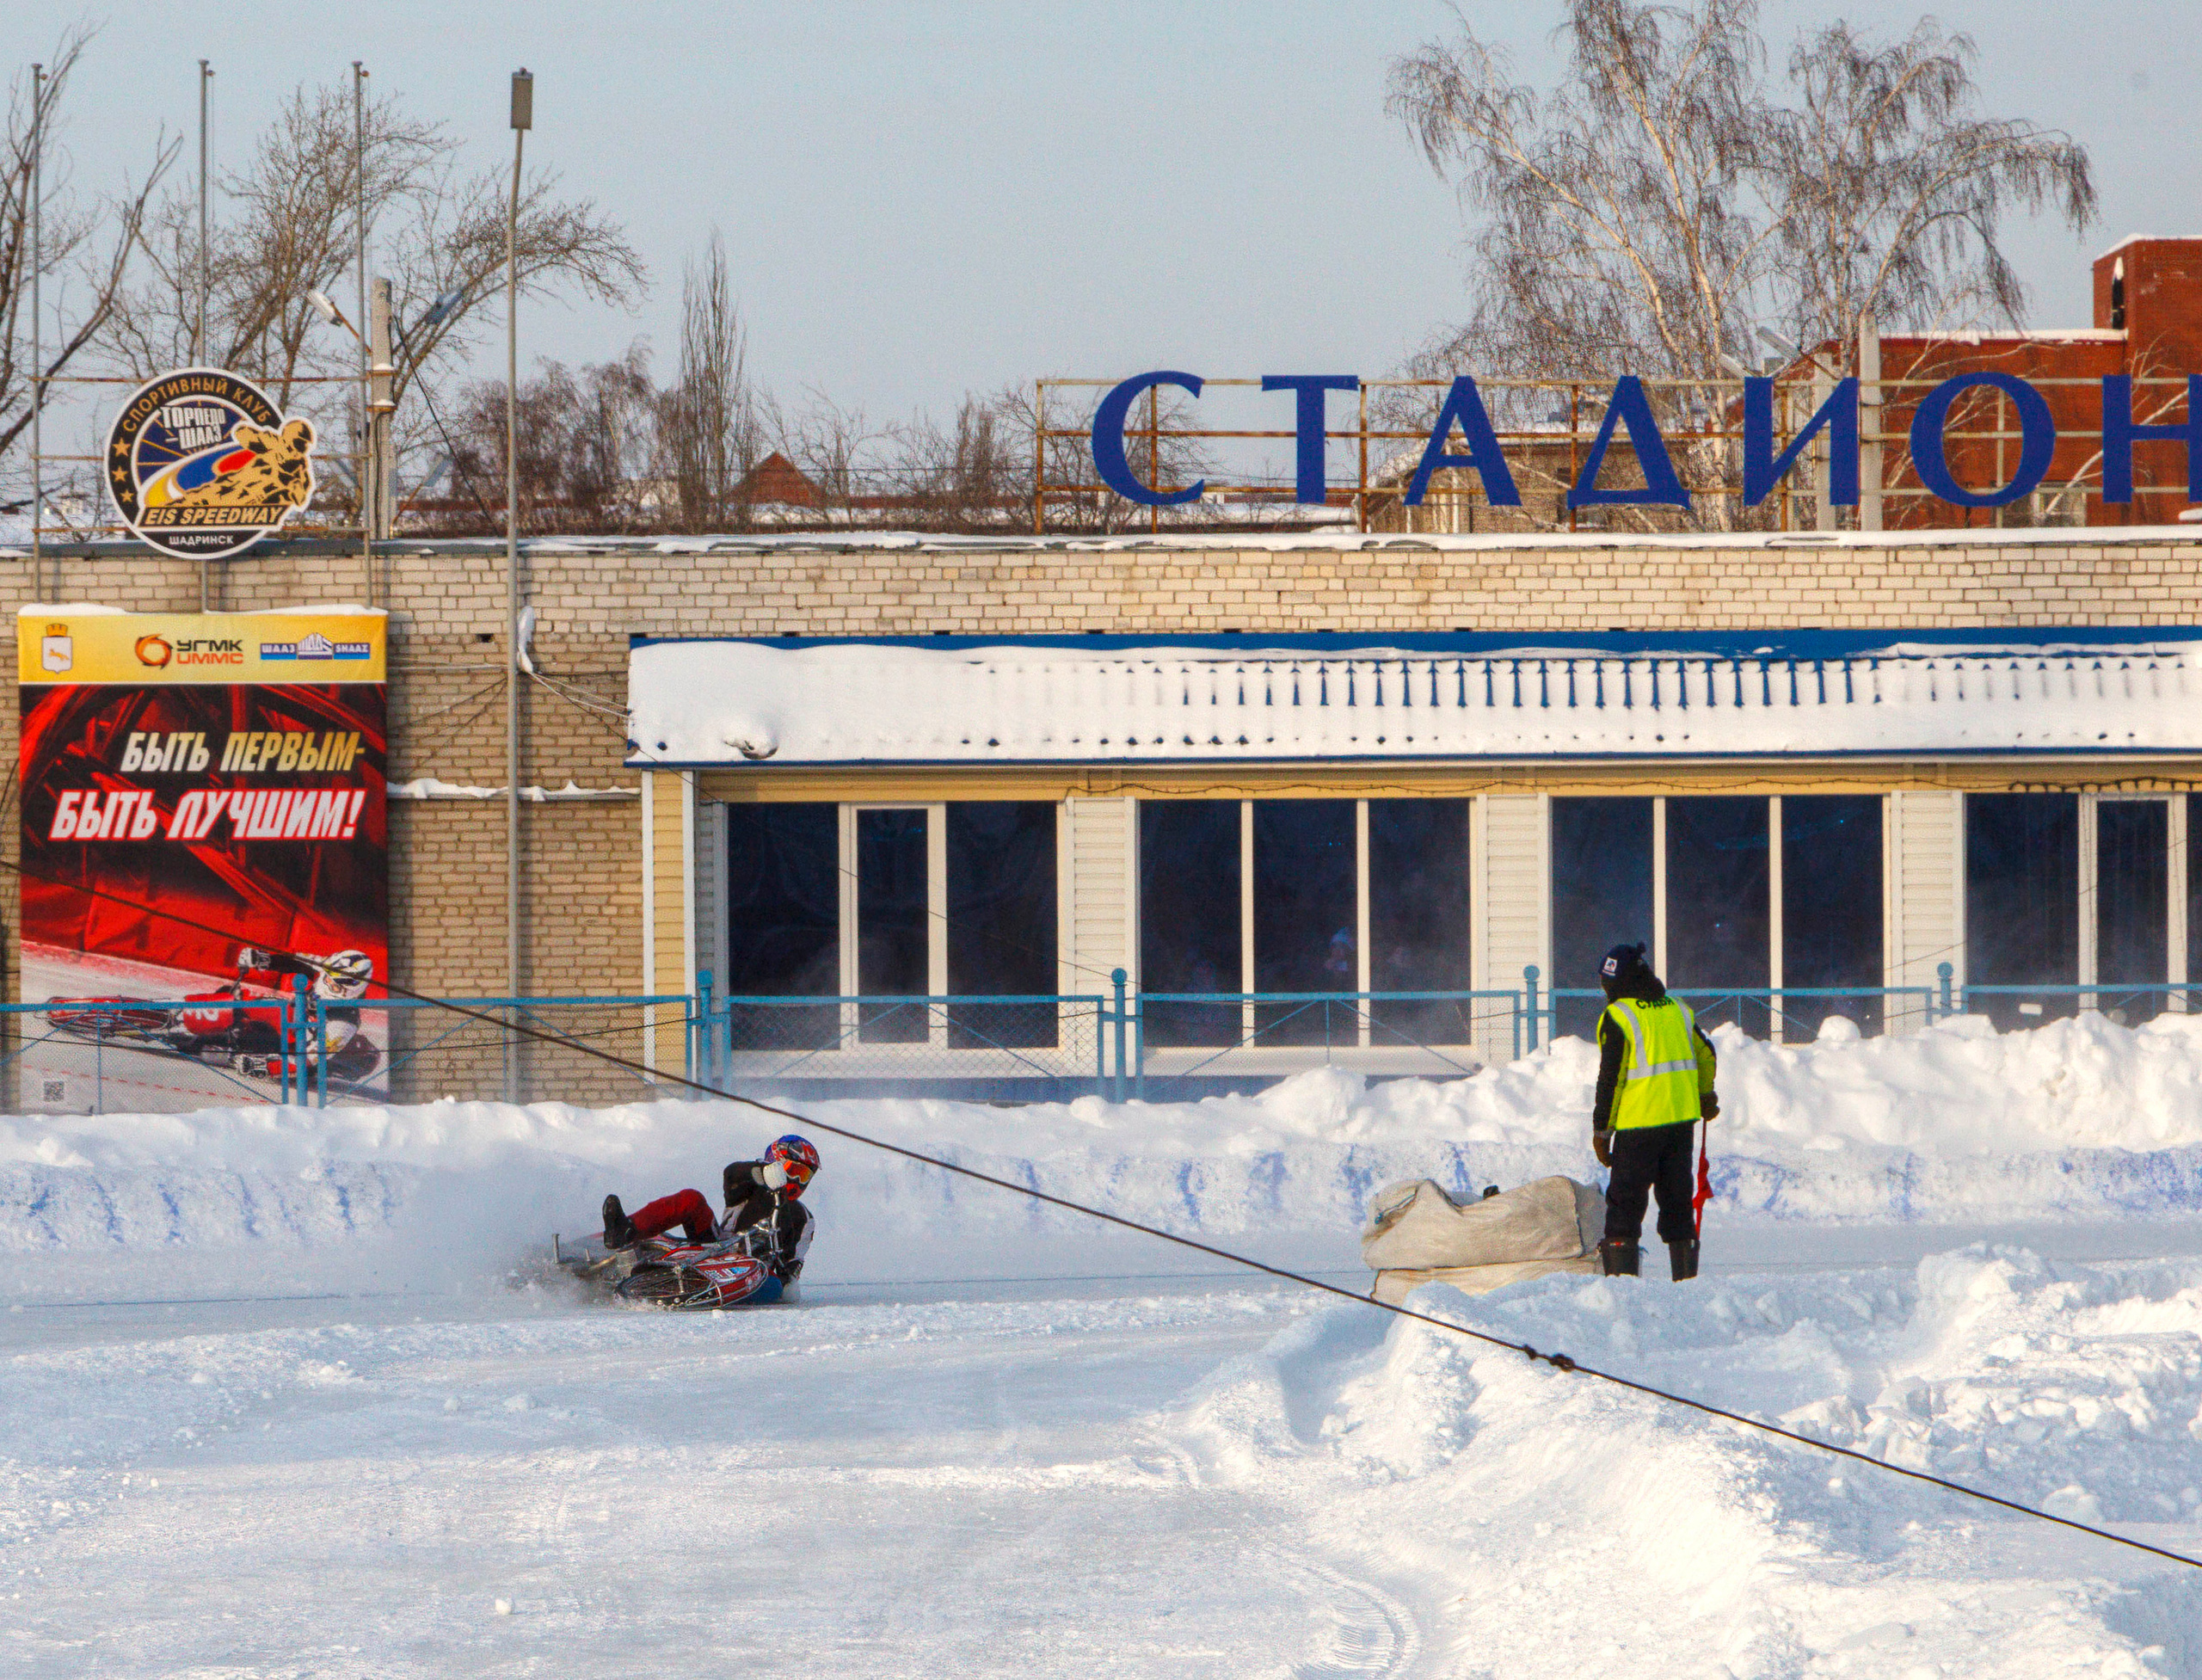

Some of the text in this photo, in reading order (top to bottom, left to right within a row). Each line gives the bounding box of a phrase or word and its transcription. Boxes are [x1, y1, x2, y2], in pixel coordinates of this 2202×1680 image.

[123, 377, 272, 432] СПОРТИВНЫЙ КЛУБ
[1092, 370, 2202, 509] СТАДИОН
[145, 507, 284, 526] EIS SPEEDWAY
[169, 535, 235, 547] ШАДРИНСК
[176, 639, 243, 652] УГМК
[261, 643, 296, 654] ШААЗ
[335, 643, 369, 654] SHAAZ
[176, 652, 244, 665] UMMC
[120, 732, 210, 772] БЫТЬ
[49, 790, 367, 841] БЫТЬ ЛУЧШИМ!
